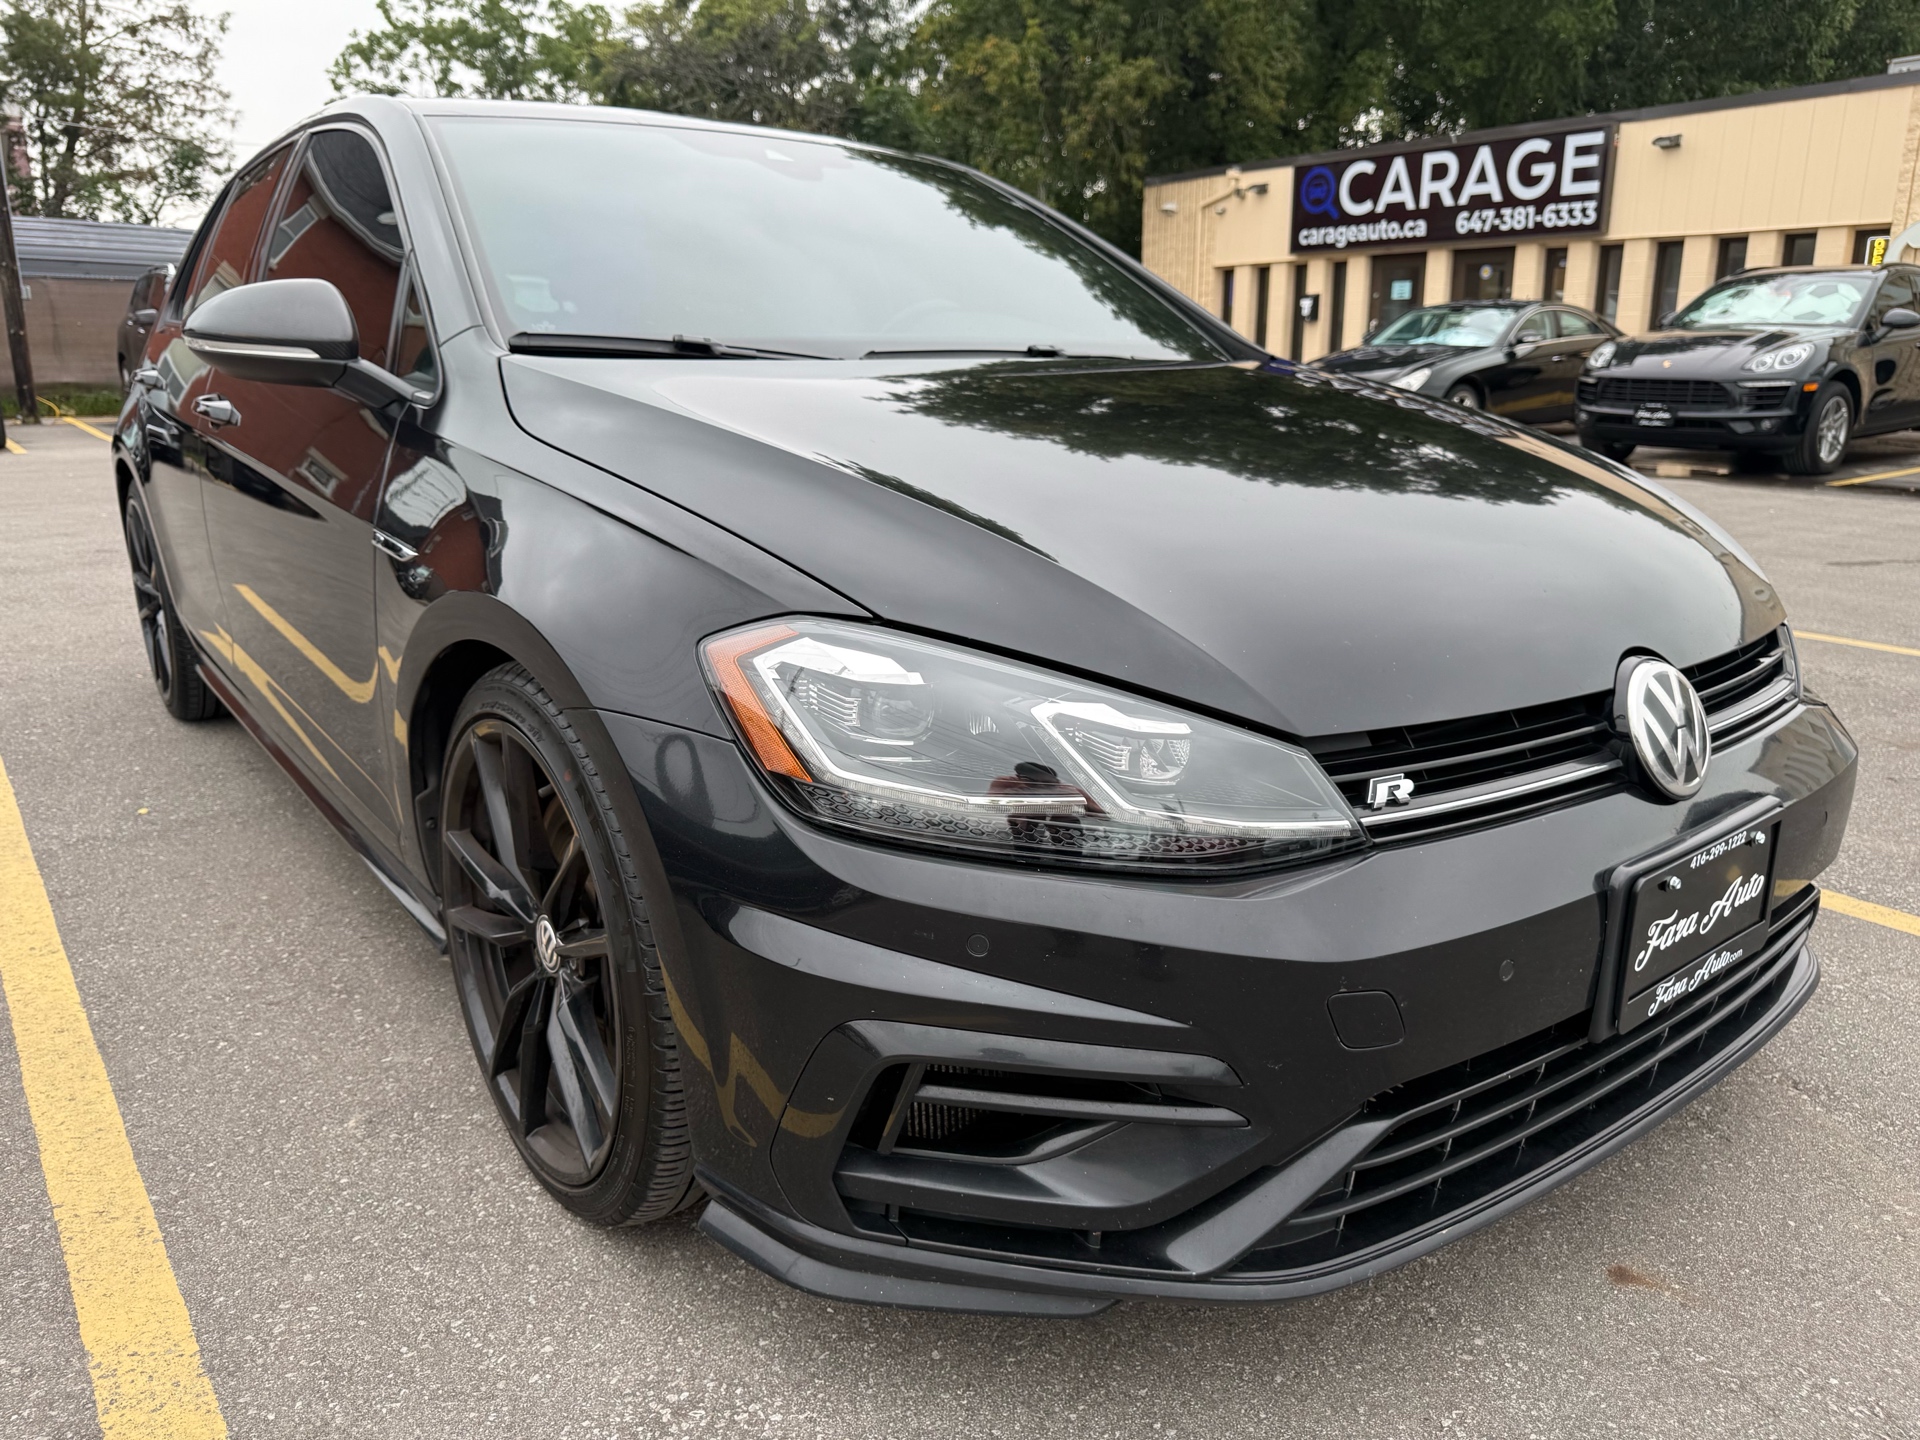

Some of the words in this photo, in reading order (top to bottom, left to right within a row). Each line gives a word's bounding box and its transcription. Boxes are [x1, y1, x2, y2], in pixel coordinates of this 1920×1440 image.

[1338, 131, 1605, 216] CARAGE
[1298, 218, 1428, 249] carageauto.ca
[1455, 200, 1598, 235] 647-381-6333
[1871, 238, 1886, 267] OPE
[1368, 773, 1415, 809] R
[1690, 831, 1747, 869] 416-299-1222
[1634, 909, 1699, 972] Fara
[1699, 873, 1765, 935] Auto
[1648, 976, 1689, 1016] Fara
[1688, 948, 1743, 992] Auto.com
